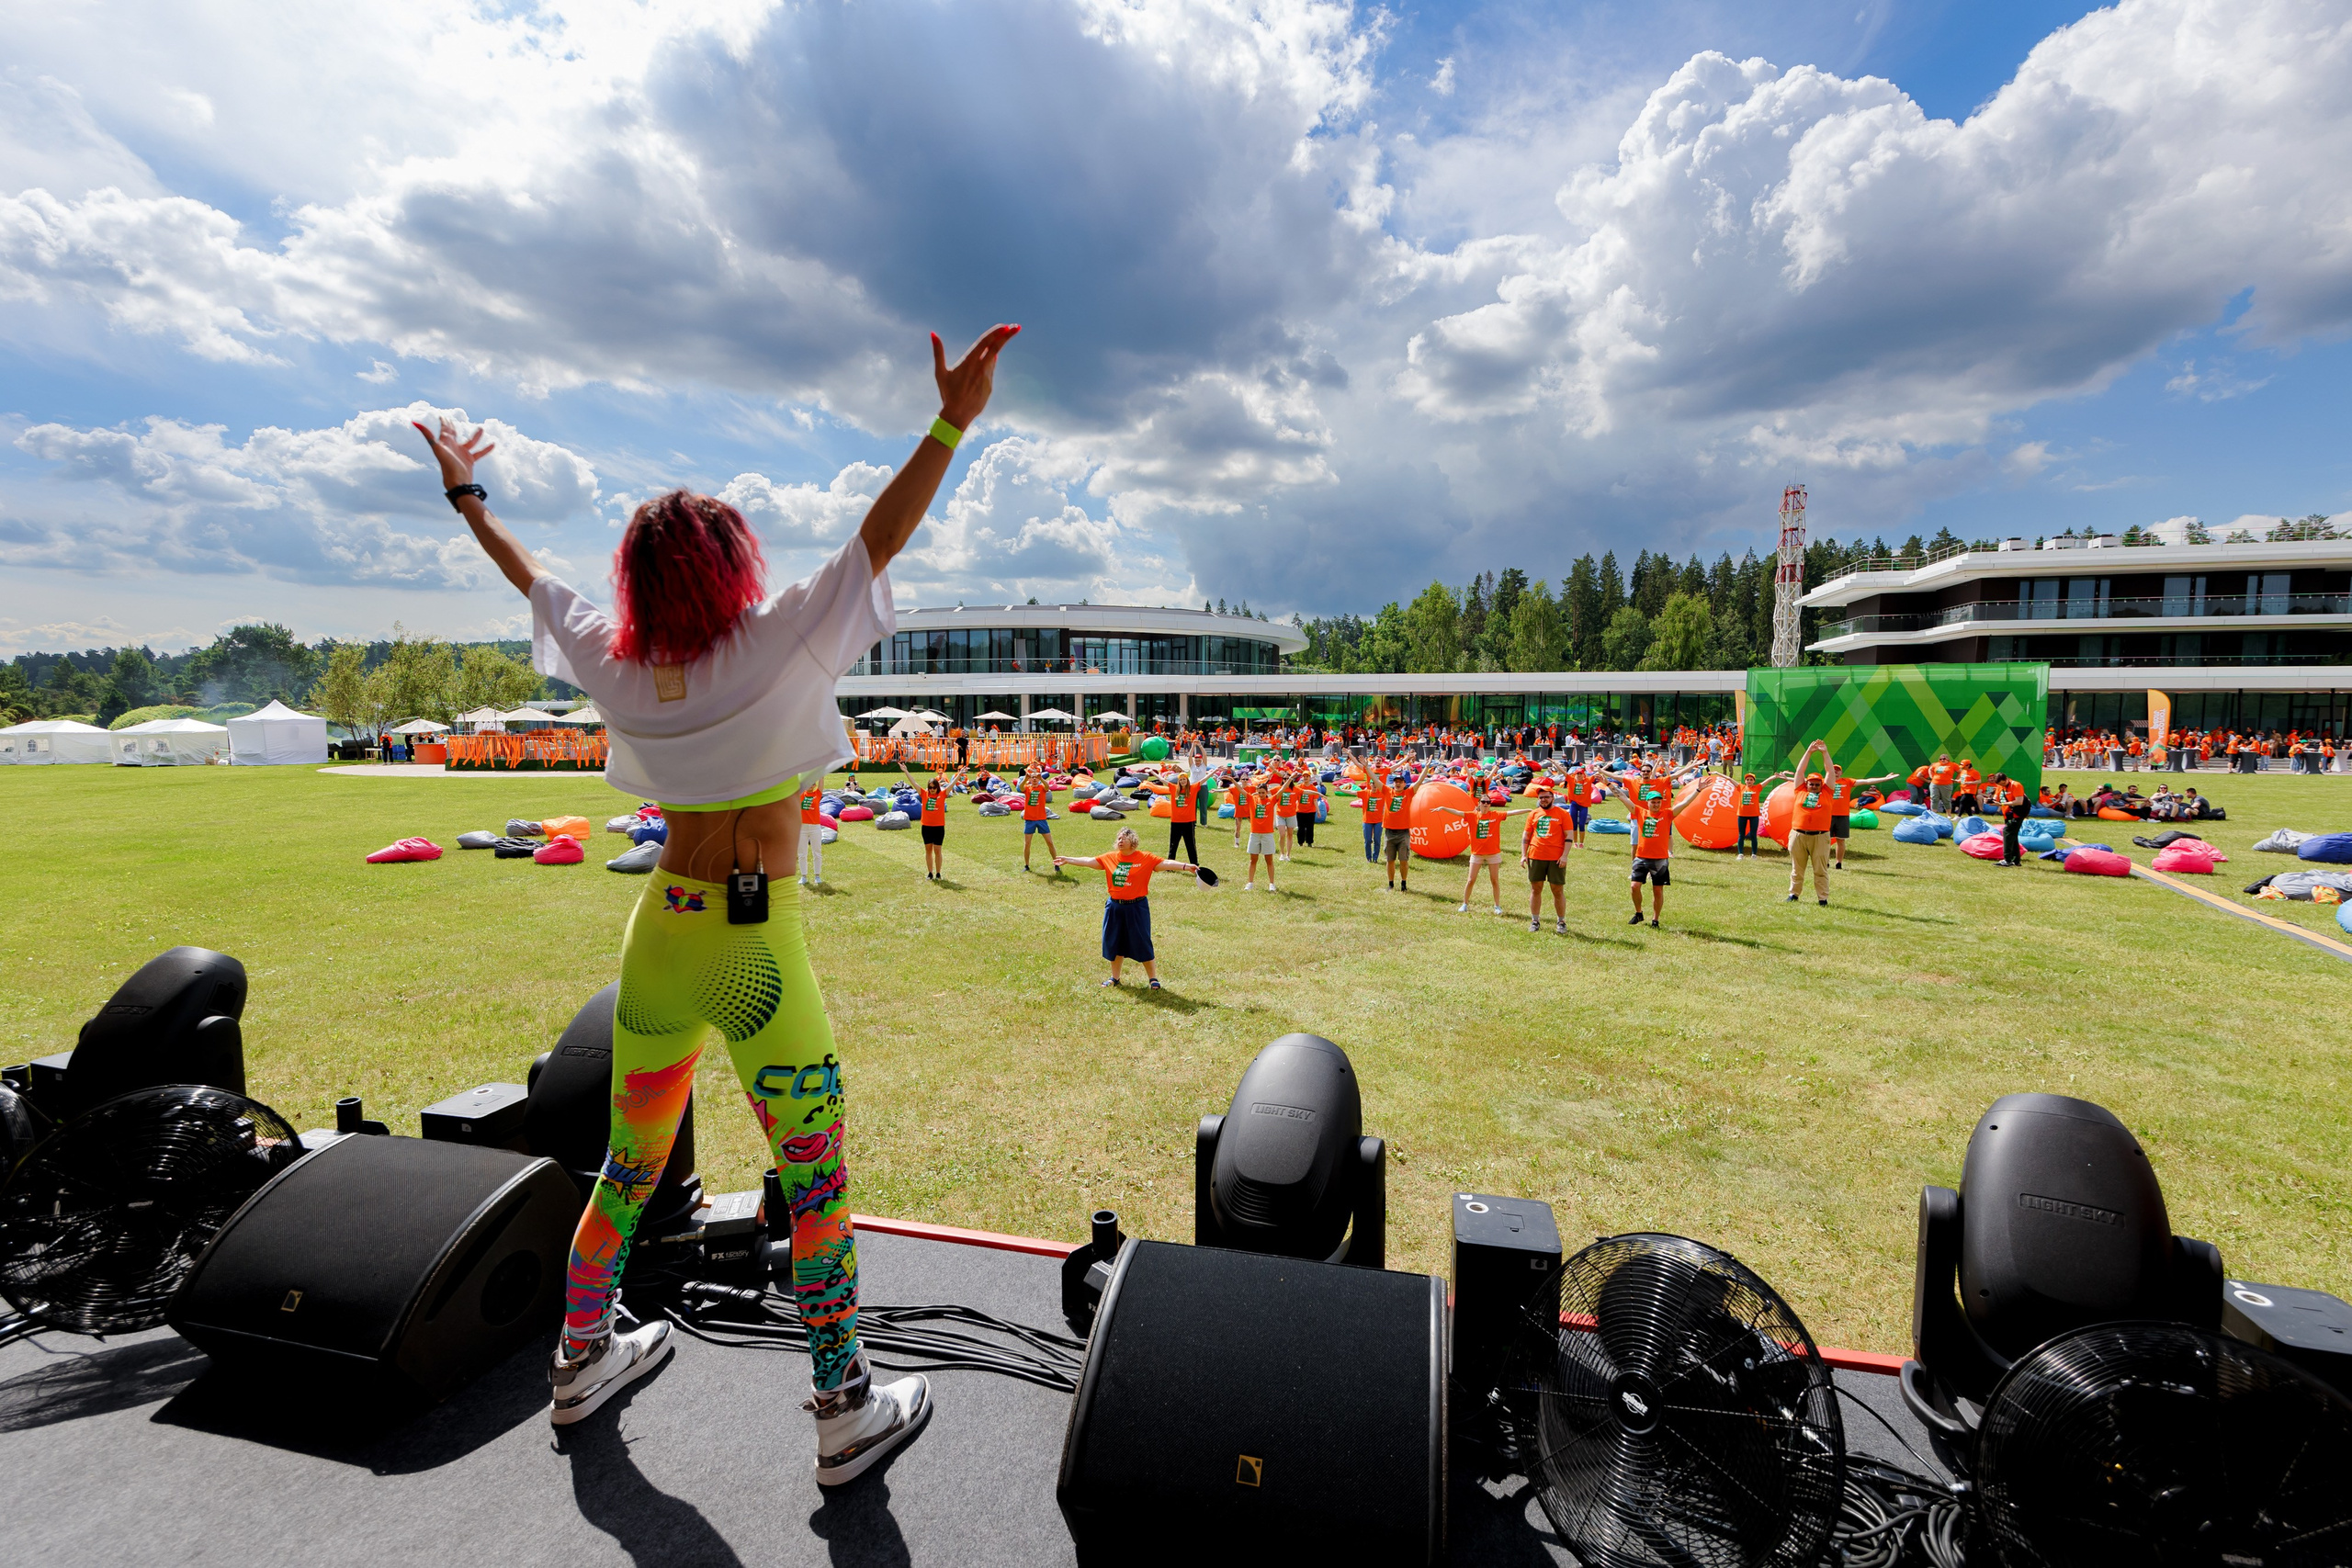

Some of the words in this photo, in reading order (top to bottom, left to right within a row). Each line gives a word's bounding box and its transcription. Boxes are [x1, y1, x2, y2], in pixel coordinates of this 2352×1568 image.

[1254, 1104, 1286, 1116] LIGHT
[1287, 1108, 1312, 1121] SKY
[2026, 1196, 2077, 1215] LIGHT
[2079, 1206, 2118, 1225] SKY
[711, 1252, 725, 1260] FX
